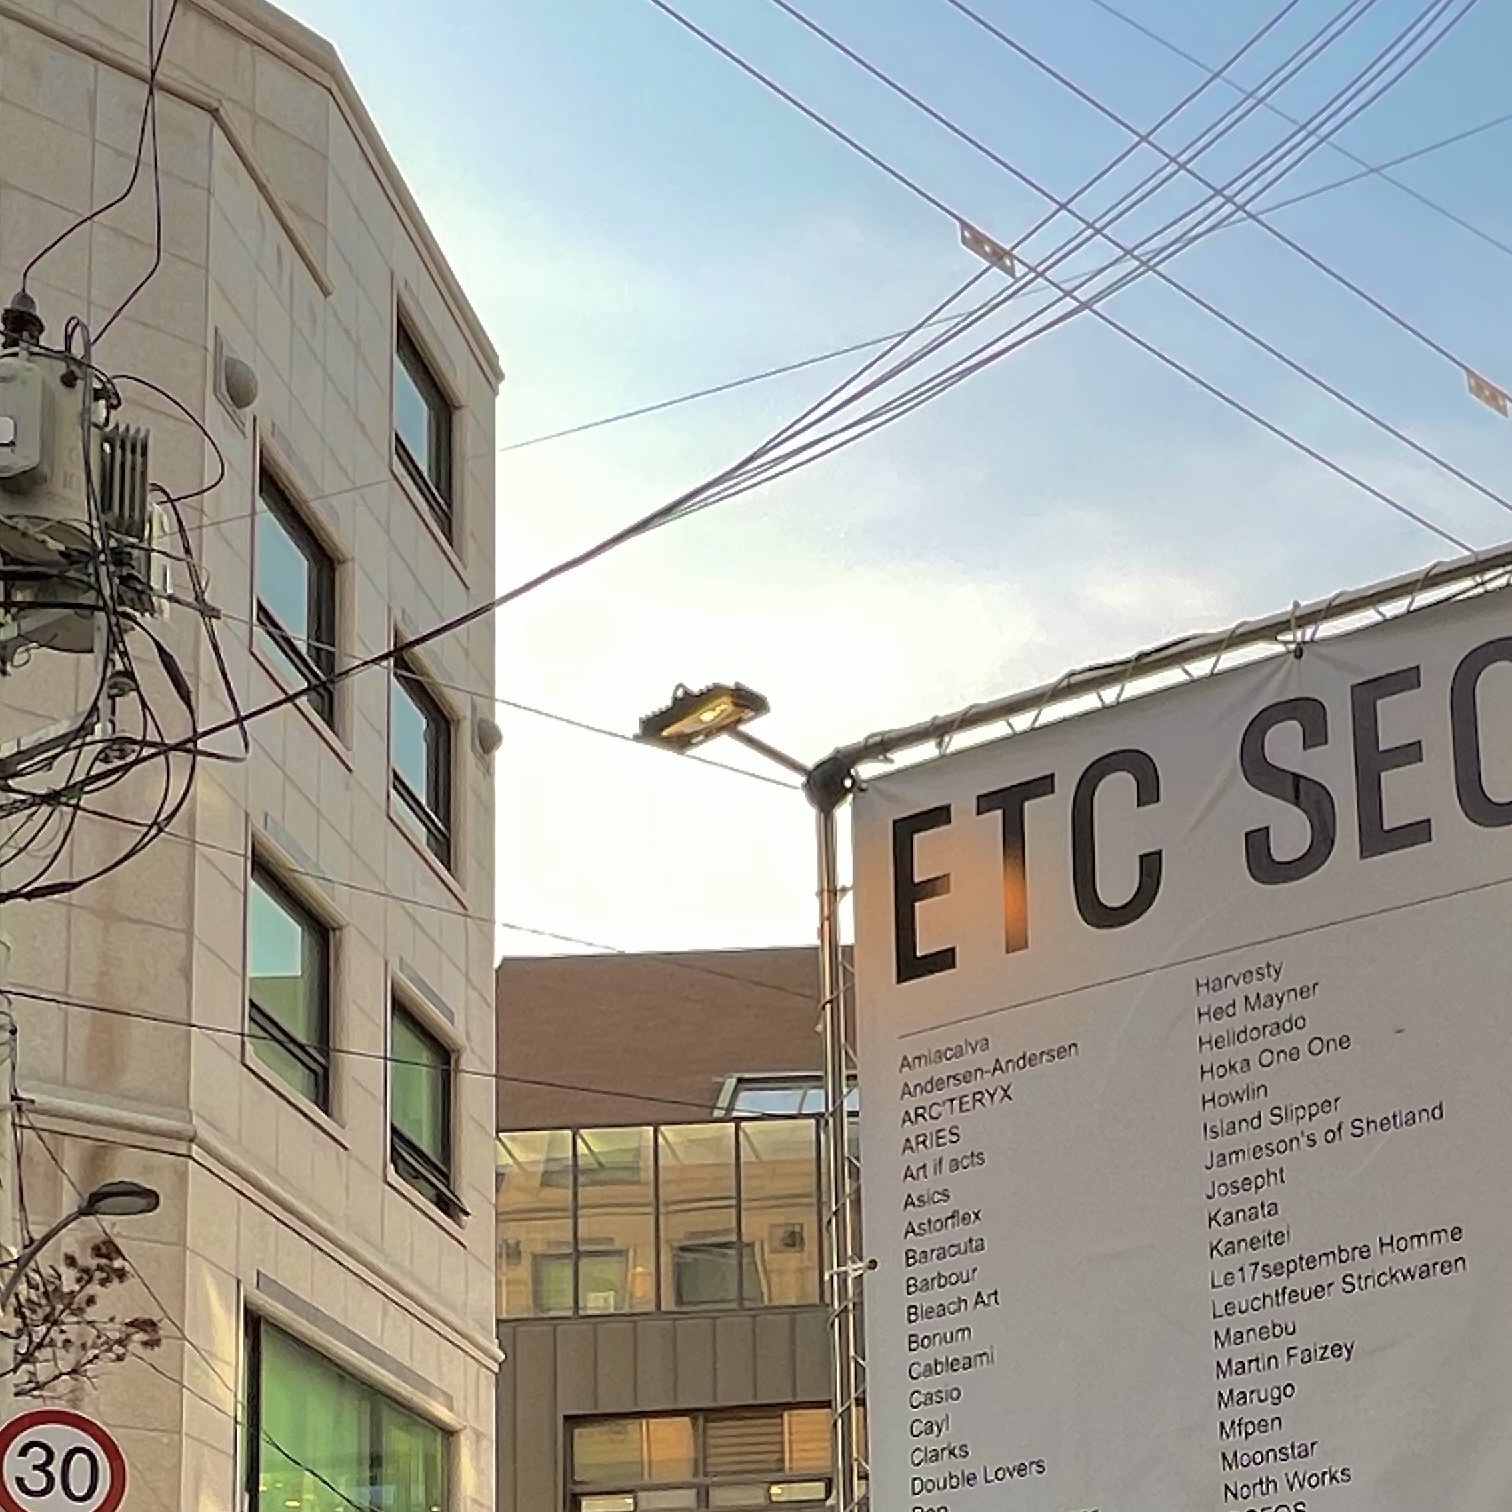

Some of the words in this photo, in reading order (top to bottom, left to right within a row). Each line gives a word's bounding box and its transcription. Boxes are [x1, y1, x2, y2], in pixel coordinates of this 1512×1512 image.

[892, 747, 1162, 984] ETC
[1195, 960, 1284, 998] Harvesty
[1196, 1001, 1237, 1025] Hed
[1243, 980, 1320, 1014] Mayner
[1198, 1014, 1306, 1054] Helldorado
[899, 1035, 990, 1073] Amiacalva
[900, 1041, 1080, 1100] Andersen-Andersen
[1200, 1057, 1251, 1083] Hoka
[1258, 1046, 1300, 1069] One
[1307, 1033, 1351, 1057] One
[901, 1084, 1013, 1128] ARC'TERYX
[1201, 1082, 1268, 1112] Howlin
[1203, 1110, 1262, 1142] Island
[1268, 1095, 1341, 1127] Slipper
[1204, 1129, 1317, 1171] Jamieson's
[1324, 1121, 1346, 1143] of
[1350, 1099, 1444, 1138] Shetland
[901, 1125, 961, 1155] ARIES
[903, 1162, 928, 1183] Art
[949, 1150, 986, 1174] acts
[1205, 1165, 1286, 1200] Josepht
[903, 1187, 951, 1211] Asics
[1208, 1200, 1279, 1230] Kanata
[903, 1208, 983, 1240] Astorflex
[904, 1236, 986, 1268] Baracuta
[1210, 1243, 1372, 1291] Le17septembre
[1378, 1224, 1463, 1256] Homme
[906, 1266, 978, 1296] Barbour
[1211, 1280, 1335, 1320] Leuchtfeuer
[1341, 1254, 1468, 1295] Strickwaren
[906, 1296, 968, 1324] Bleach
[972, 1288, 1000, 1310] Art
[908, 1326, 972, 1352] Bonum
[1213, 1319, 1297, 1350] Manebu
[908, 1346, 995, 1381] Cableami
[1215, 1351, 1280, 1381] Martin
[908, 1385, 962, 1411] Casio
[1217, 1381, 1296, 1411] Marugo
[910, 1413, 950, 1439] Cayl
[1218, 1414, 1282, 1442] Mfpen
[15, 1440, 99, 1502] 30
[911, 1442, 970, 1468] Clarks
[1220, 1439, 1319, 1472] Moonstar
[911, 1470, 978, 1497] Double
[982, 1457, 1046, 1485] Lovers
[1224, 1475, 1278, 1503] North
[1285, 1465, 1352, 1493] Works
